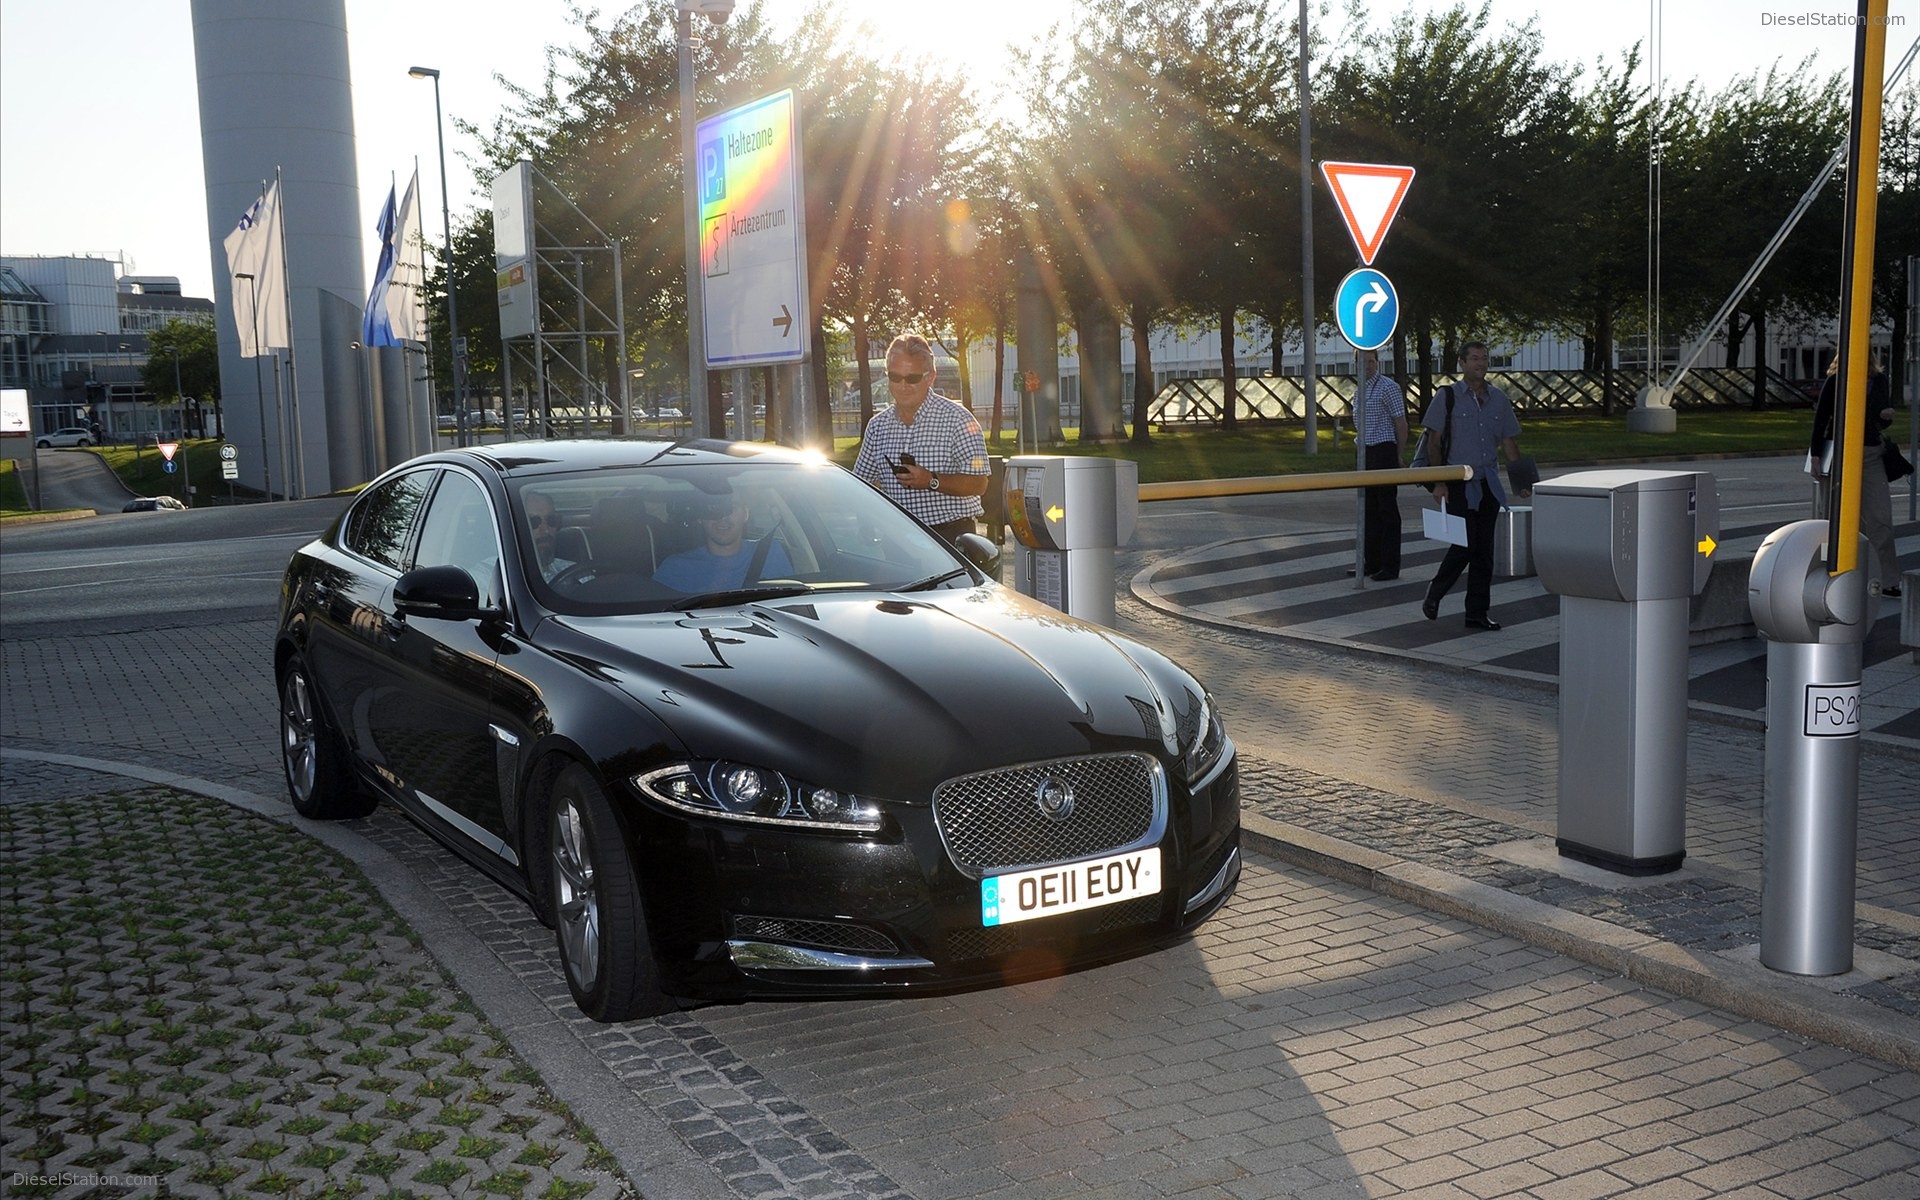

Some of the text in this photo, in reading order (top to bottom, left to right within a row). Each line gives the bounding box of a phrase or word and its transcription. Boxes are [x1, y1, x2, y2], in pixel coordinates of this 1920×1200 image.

[728, 127, 773, 159] Haltezone
[703, 147, 718, 199] P
[730, 208, 786, 238] Ärztezentrum
[1018, 856, 1142, 912] OE11 EOY
